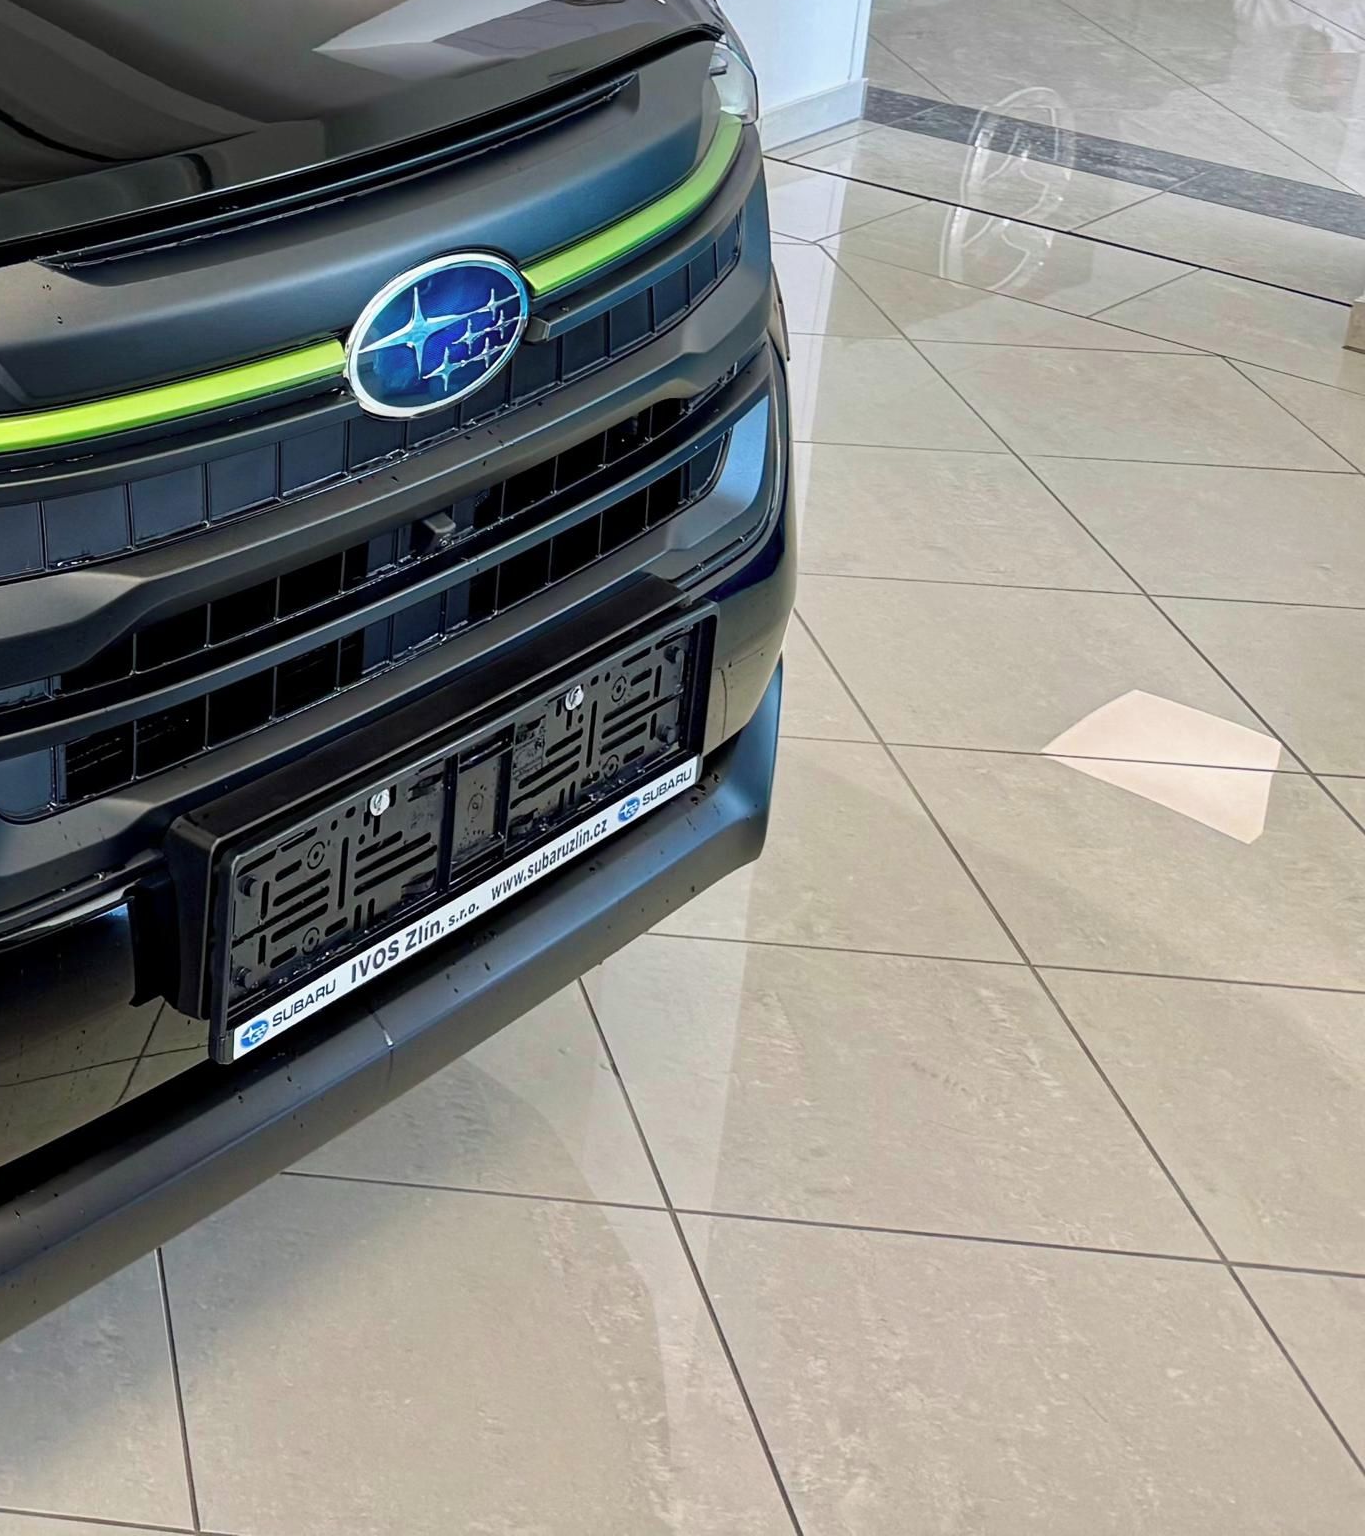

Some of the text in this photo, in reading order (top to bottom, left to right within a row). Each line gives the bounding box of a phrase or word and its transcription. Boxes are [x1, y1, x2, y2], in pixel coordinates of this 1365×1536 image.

[271, 766, 693, 1028] SUBARU IVOS Zlín, s.r.o. www.subaruzlin.cz SUBARU
